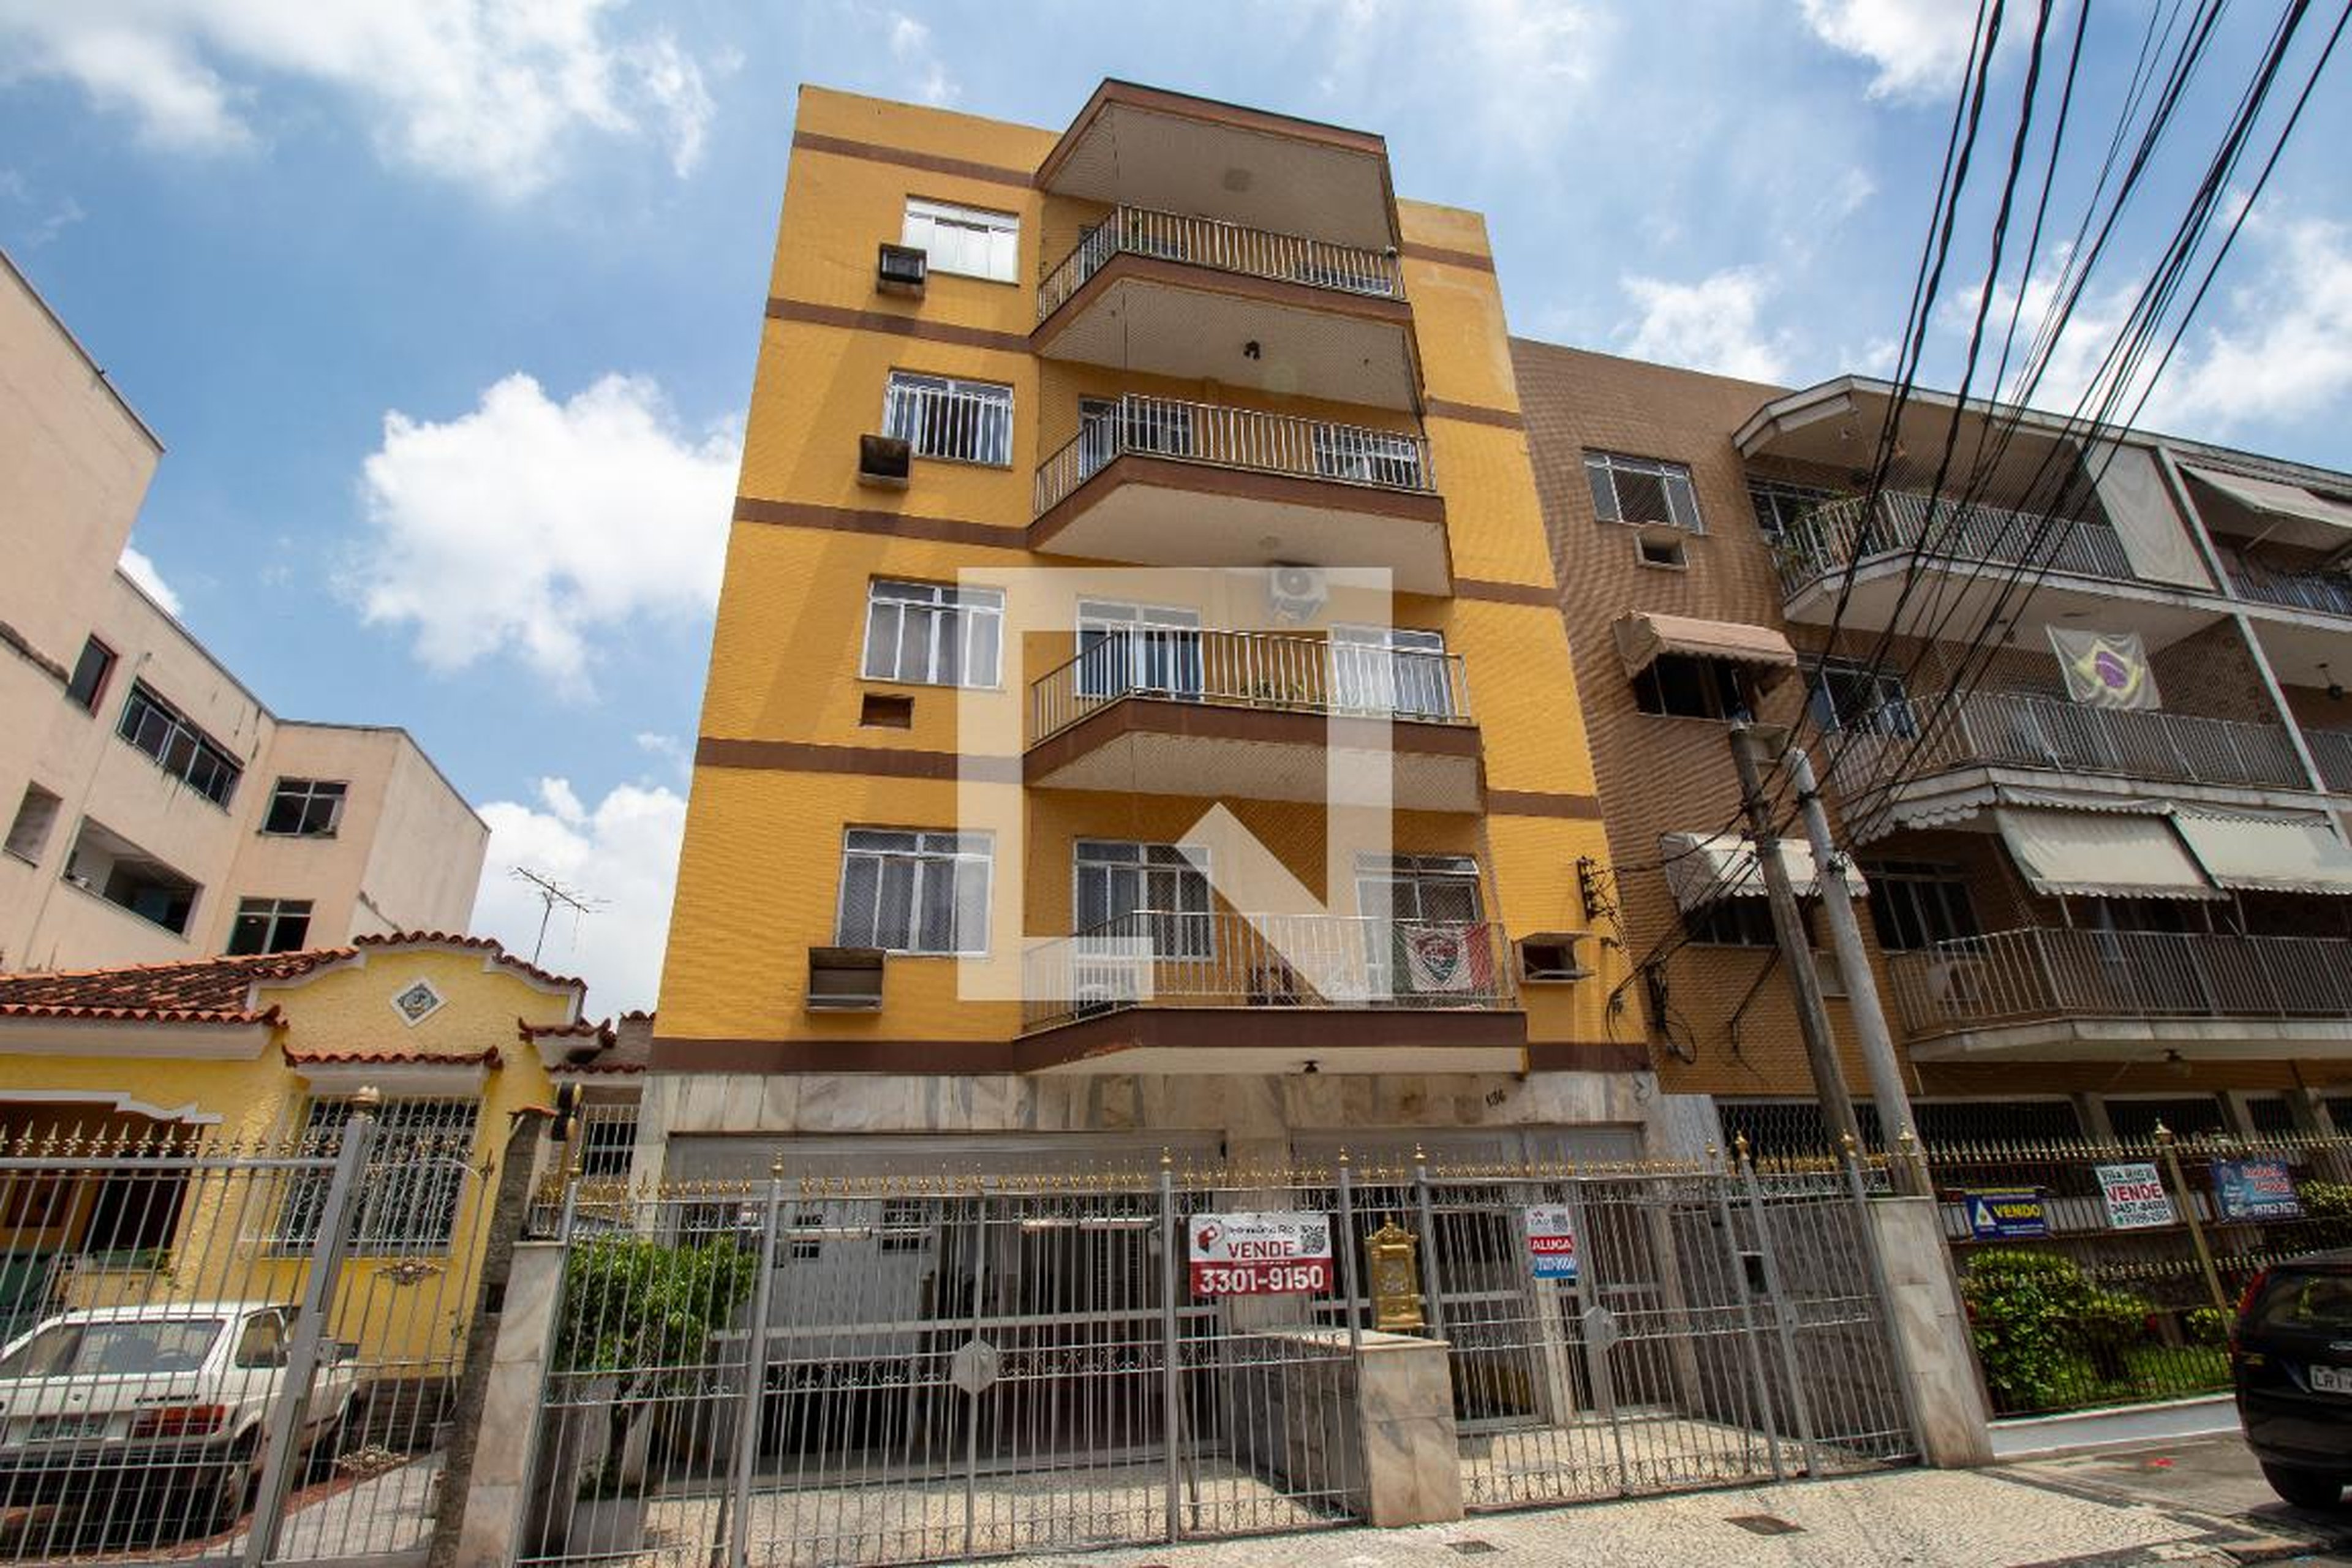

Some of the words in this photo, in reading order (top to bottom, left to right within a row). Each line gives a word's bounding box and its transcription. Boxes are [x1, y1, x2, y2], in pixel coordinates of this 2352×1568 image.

[2107, 1183, 2162, 1201] VENDE
[1992, 1204, 2041, 1218] VENDO
[1227, 1241, 1294, 1258] VENDE
[1200, 1265, 1324, 1292] 3301-9150
